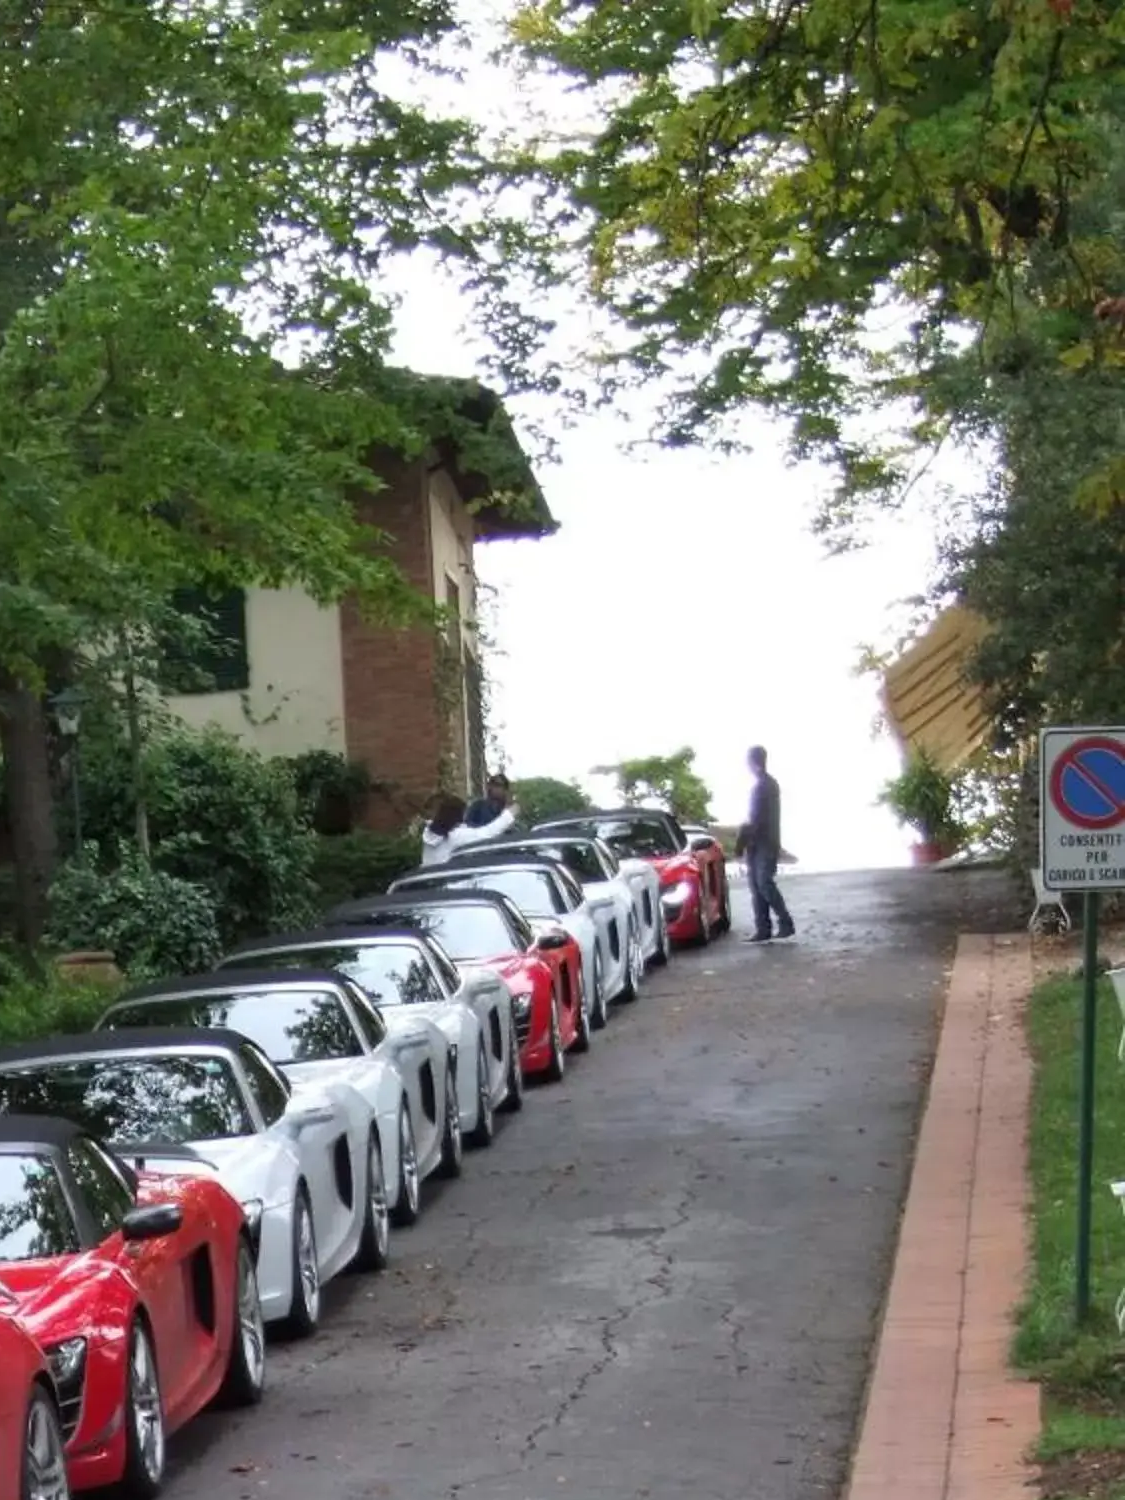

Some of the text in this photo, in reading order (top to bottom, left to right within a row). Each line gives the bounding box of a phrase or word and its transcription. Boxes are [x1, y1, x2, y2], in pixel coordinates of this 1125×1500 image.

[1060, 833, 1125, 848] CONSENTIT
[1086, 851, 1108, 864] PER
[1048, 868, 1086, 881] CARICO
